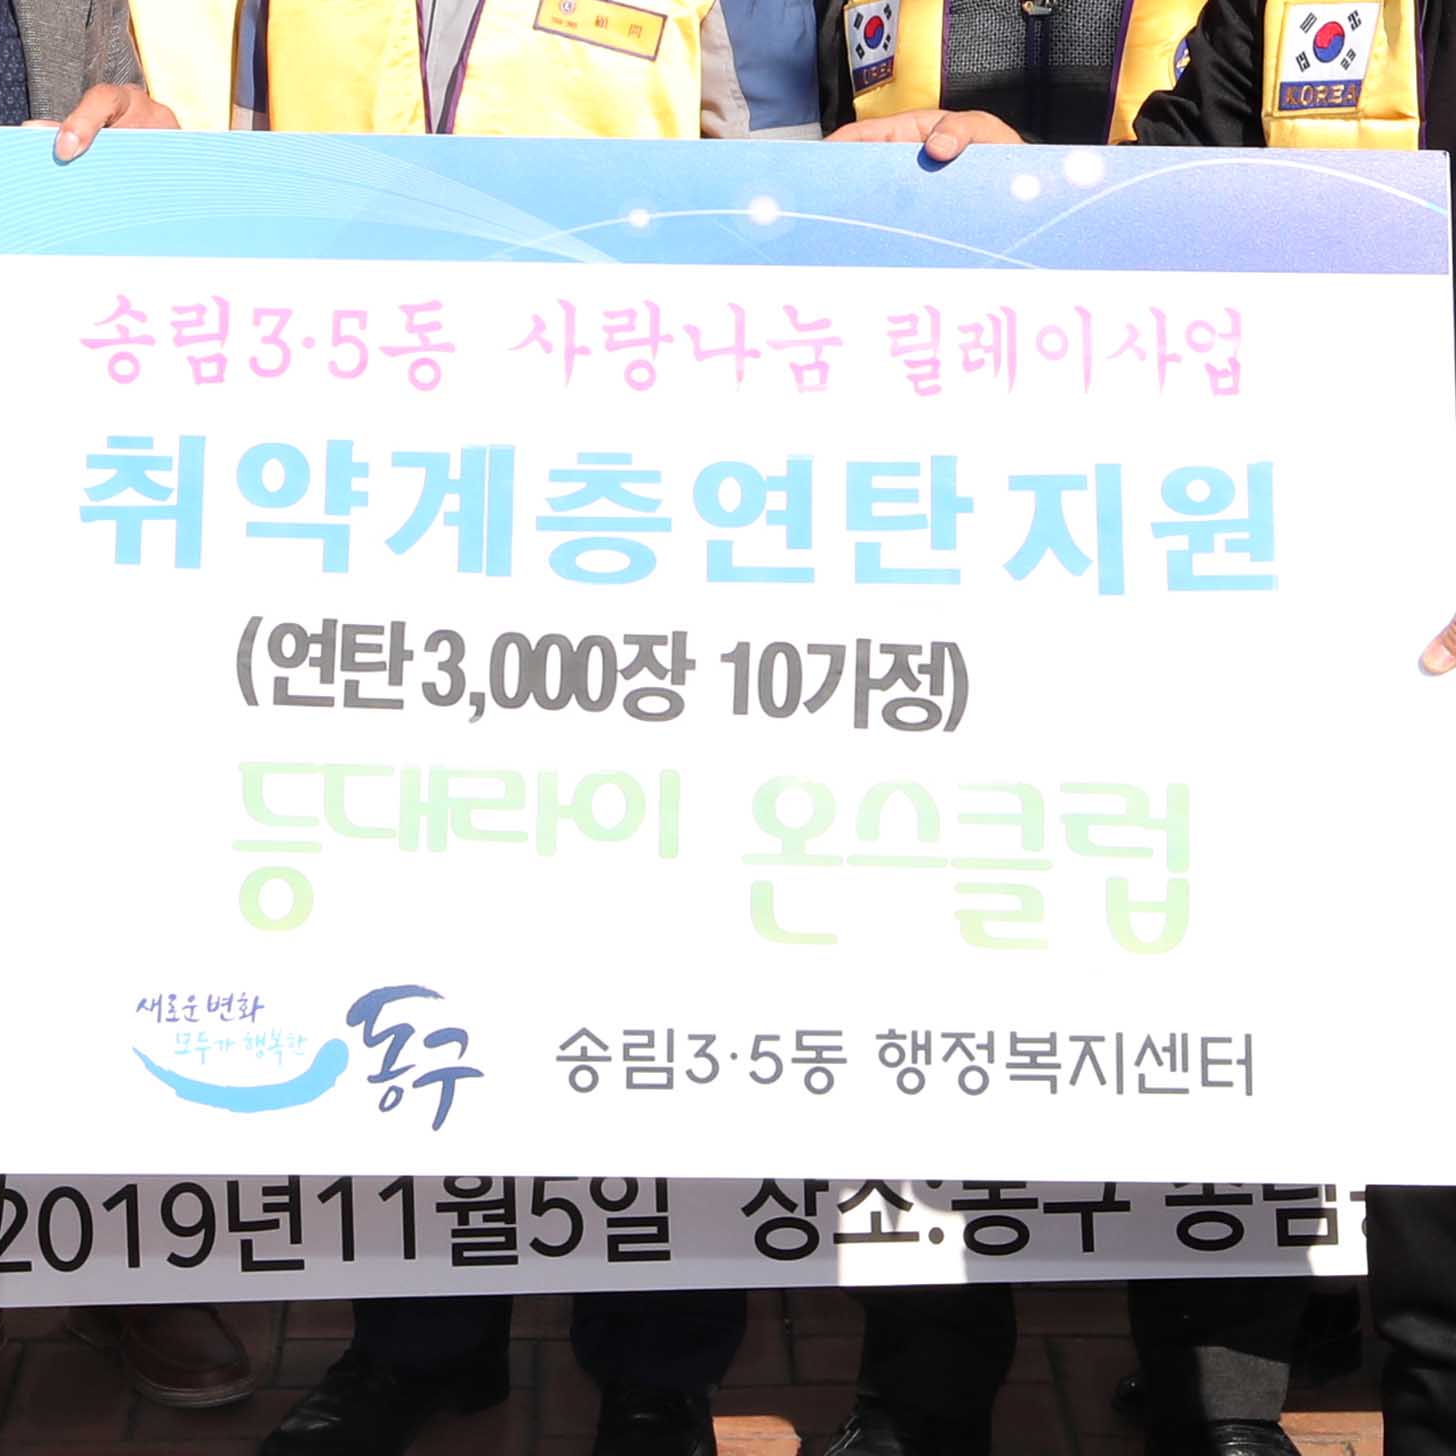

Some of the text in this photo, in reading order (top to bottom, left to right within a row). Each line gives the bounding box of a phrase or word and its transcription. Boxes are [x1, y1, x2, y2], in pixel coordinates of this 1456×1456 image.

[1285, 82, 1359, 106] KOREA
[510, 299, 844, 395] 사랑나눔
[887, 305, 1244, 399] 릴레이사업
[235, 616, 970, 734] (연탄3,000장 10가정)
[231, 761, 1192, 956] 등대라이 온스클럽
[136, 992, 266, 1024] 새로운 변화
[174, 1029, 310, 1066] 모두가 행복한
[344, 984, 486, 1133] 동구
[555, 1027, 1254, 1098] 송림3·5동 행정복지센터
